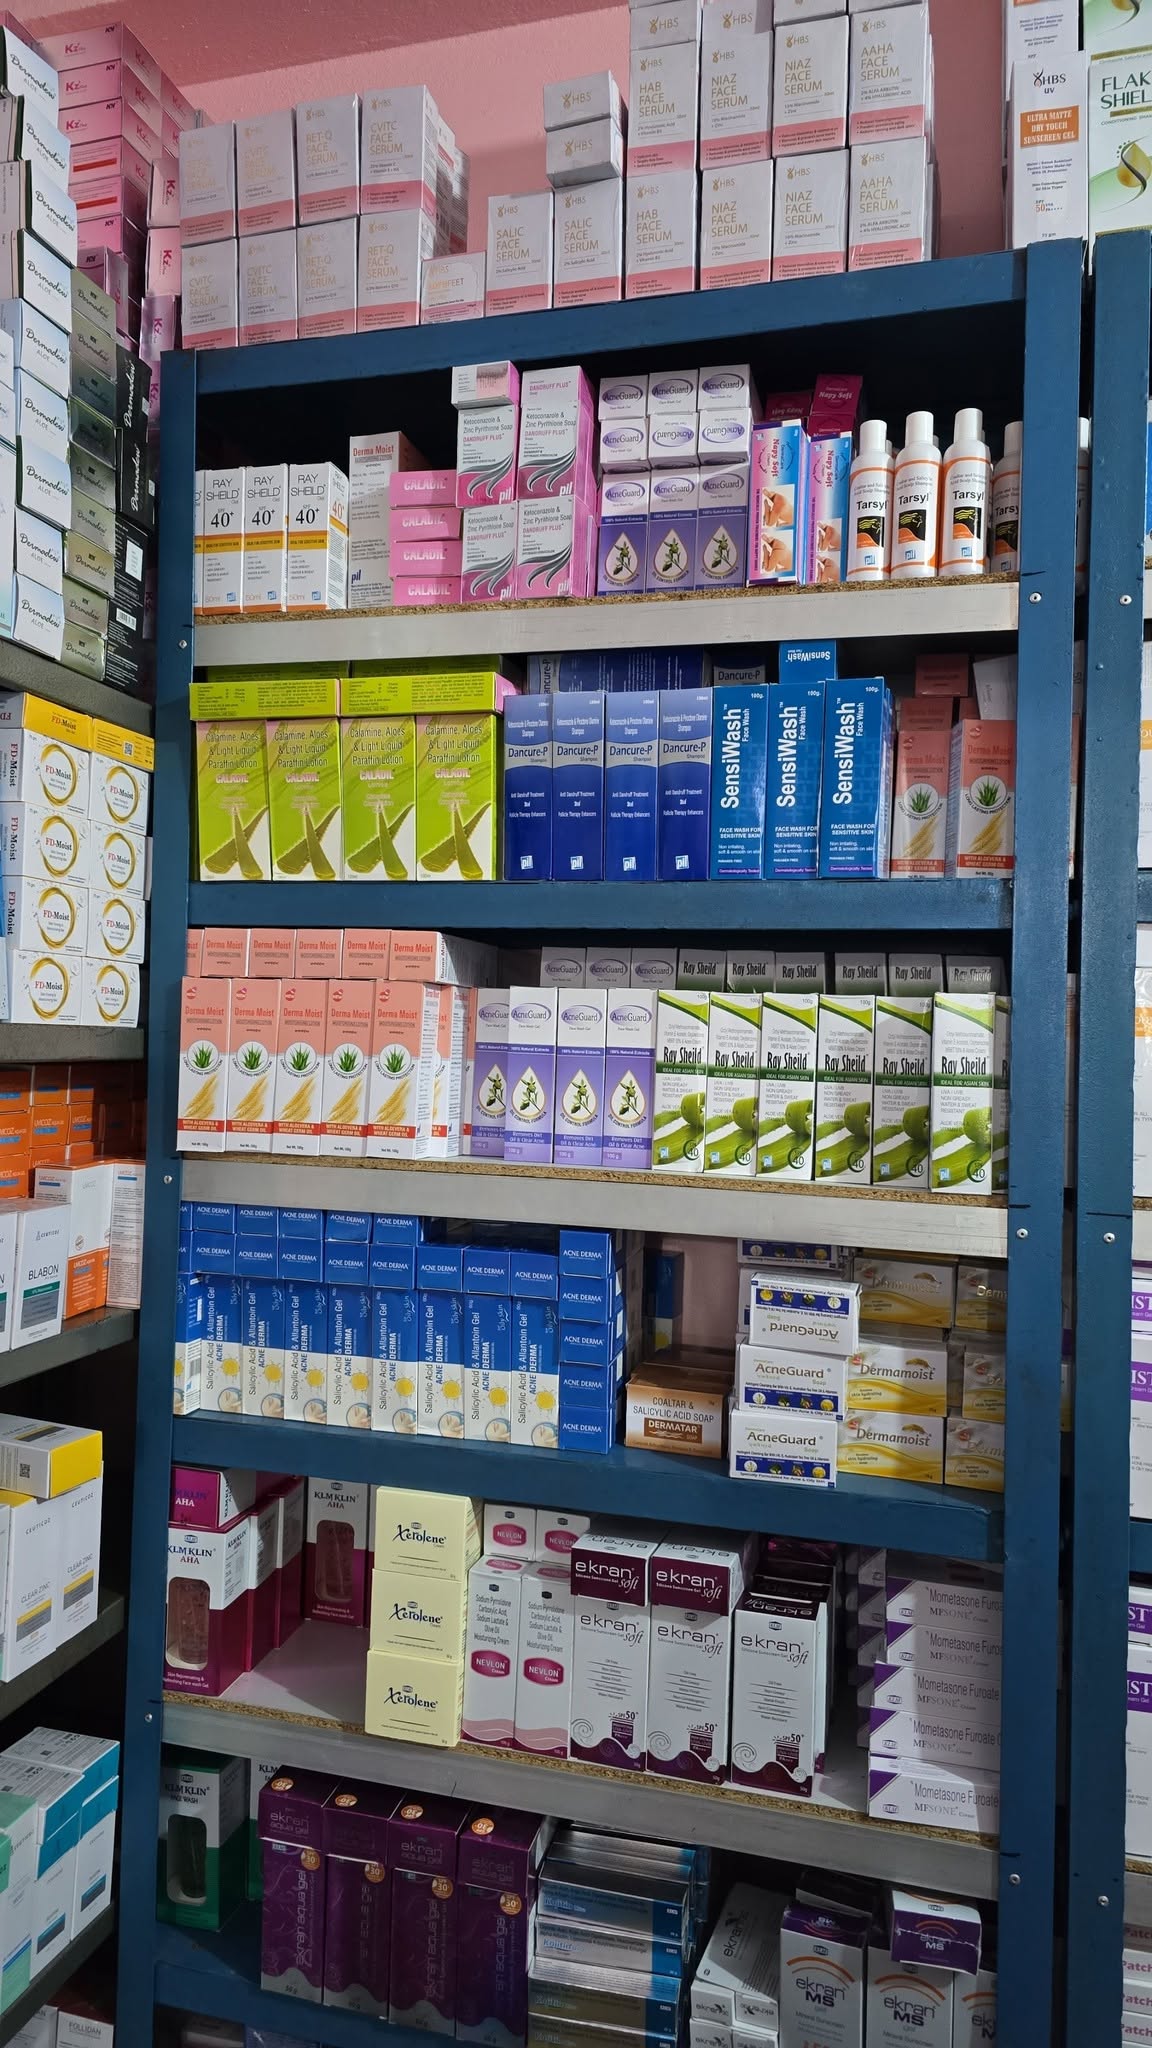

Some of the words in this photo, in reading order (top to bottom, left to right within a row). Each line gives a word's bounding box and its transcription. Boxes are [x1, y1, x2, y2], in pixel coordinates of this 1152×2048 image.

[733, 13, 752, 25] HBS
[870, 20, 886, 30] HBS
[861, 43, 894, 57] AAHA
[785, 58, 811, 71] NIAZ
[861, 56, 888, 69] FACE
[785, 70, 811, 83] FACE
[861, 66, 900, 82] SERUM
[1042, 73, 1066, 85] HBS
[640, 81, 661, 93] HAB
[1102, 70, 1151, 92] FLAK
[785, 80, 822, 96] SERUM
[1044, 86, 1055, 94] uv
[639, 93, 665, 105] FACE
[639, 104, 675, 117] SERUM
[1027, 111, 1048, 123] ULTRA
[1049, 110, 1072, 120] MATTE
[1031, 122, 1045, 132] DRY
[1046, 121, 1067, 130] TOUCH
[1024, 134, 1061, 145] SUNSCREEN
[1062, 132, 1075, 140] GEL
[1035, 204, 1045, 212] 50
[497, 226, 524, 240] SALIC
[497, 238, 520, 250] FACE
[368, 255, 390, 267] FACE
[497, 249, 530, 263] SERUM
[368, 266, 399, 279] SERUM
[602, 390, 640, 402] AcneGuard
[352, 446, 374, 457] Derma
[375, 445, 394, 454] Moist
[254, 476, 274, 486] RAY
[297, 474, 318, 484] RAY
[404, 478, 446, 491] CALADIL
[247, 487, 280, 498] SHEILD
[291, 485, 324, 497] SHEILD
[953, 491, 984, 501] Tarsyl
[899, 493, 929, 505] Tarsyl
[403, 548, 445, 560] CALADIL
[788, 651, 830, 661] SensiWash
[557, 745, 599, 756] Dancure-P
[663, 742, 706, 753] Dancure-P
[834, 702, 855, 804] SensiWash
[721, 708, 741, 808] SensiWash
[777, 706, 797, 807] SensiWash
[10, 743, 18, 787] FD-Moist
[45, 765, 71, 780] FD-Moist
[110, 785, 133, 799] FD-Moist
[394, 943, 413, 953] Derma
[414, 944, 433, 953] Moist
[683, 961, 696, 975] Ray
[697, 961, 716, 975] Sheild
[185, 1006, 204, 1016] Derma
[206, 1007, 224, 1017] Moist
[512, 1009, 547, 1020] AcneGuard
[562, 1012, 598, 1022] AcneGuard
[942, 1056, 957, 1075] Ray
[960, 1057, 986, 1076] Sheild
[581, 1251, 601, 1259] DERMA
[29, 1264, 59, 1280] BLABON
[770, 1322, 838, 1339] AcneGuard
[519, 1328, 527, 1362] Allantoin
[529, 1344, 537, 1371] DERMA
[755, 1363, 824, 1378] AcneGuard
[860, 1364, 934, 1380] Dermamoist
[581, 1380, 602, 1388] DERMA
[518, 1393, 527, 1423] Salicylic
[653, 1397, 686, 1409] COALTAR
[689, 1401, 694, 1409] &
[633, 1406, 672, 1417] SALICYLIC
[673, 1411, 691, 1420] ACID
[694, 1413, 714, 1423] SOAP
[649, 1420, 697, 1433] DERMATAR
[175, 1498, 195, 1507] AHA
[392, 1524, 446, 1544] Xerolene
[575, 1560, 632, 1579] ekran
[618, 1576, 640, 1594] soft
[740, 1633, 801, 1654] ekran
[786, 1651, 809, 1667] soft
[529, 1666, 558, 1677] NEVLON
[917, 1675, 967, 1697] Mometasone
[969, 1683, 999, 1701] Furoate
[384, 1687, 438, 1708] Xerolene
[796, 1977, 845, 2000] ekran
[805, 1990, 835, 2008] MS
